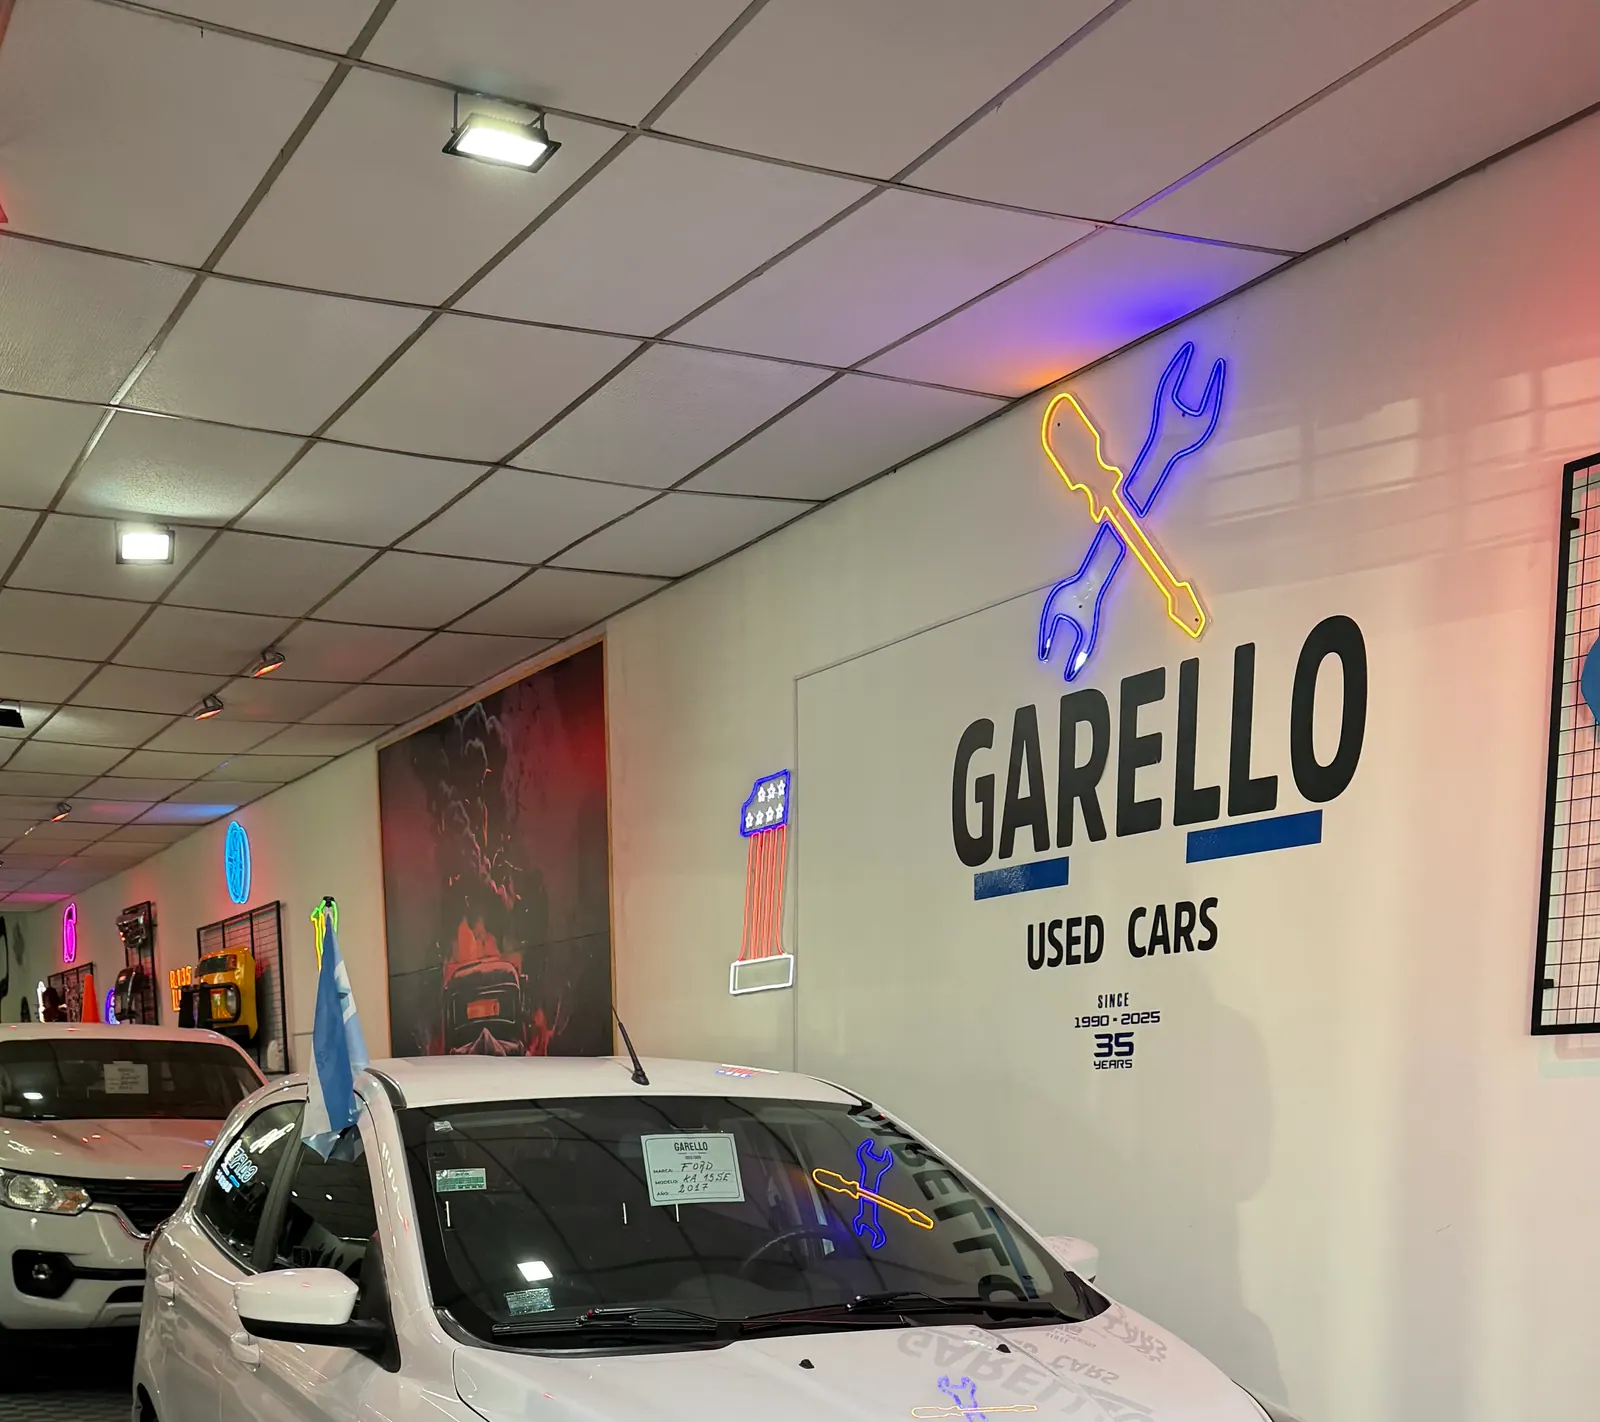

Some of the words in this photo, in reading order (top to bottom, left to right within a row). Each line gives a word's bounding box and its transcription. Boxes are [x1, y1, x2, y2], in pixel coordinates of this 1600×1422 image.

[952, 614, 1368, 867] GARELLO
[1027, 914, 1105, 971] USED
[1127, 897, 1219, 958] CARS
[1097, 992, 1129, 1009] SINCE
[1074, 1014, 1110, 1028] 1990
[1120, 1010, 1161, 1025] 2025
[1093, 1031, 1135, 1058] 35
[1093, 1059, 1133, 1070] YEARS
[673, 1141, 708, 1151] GARELLO
[680, 1161, 713, 1173] FORD
[682, 1173, 698, 1183] KA
[678, 1183, 708, 1193] 2017
